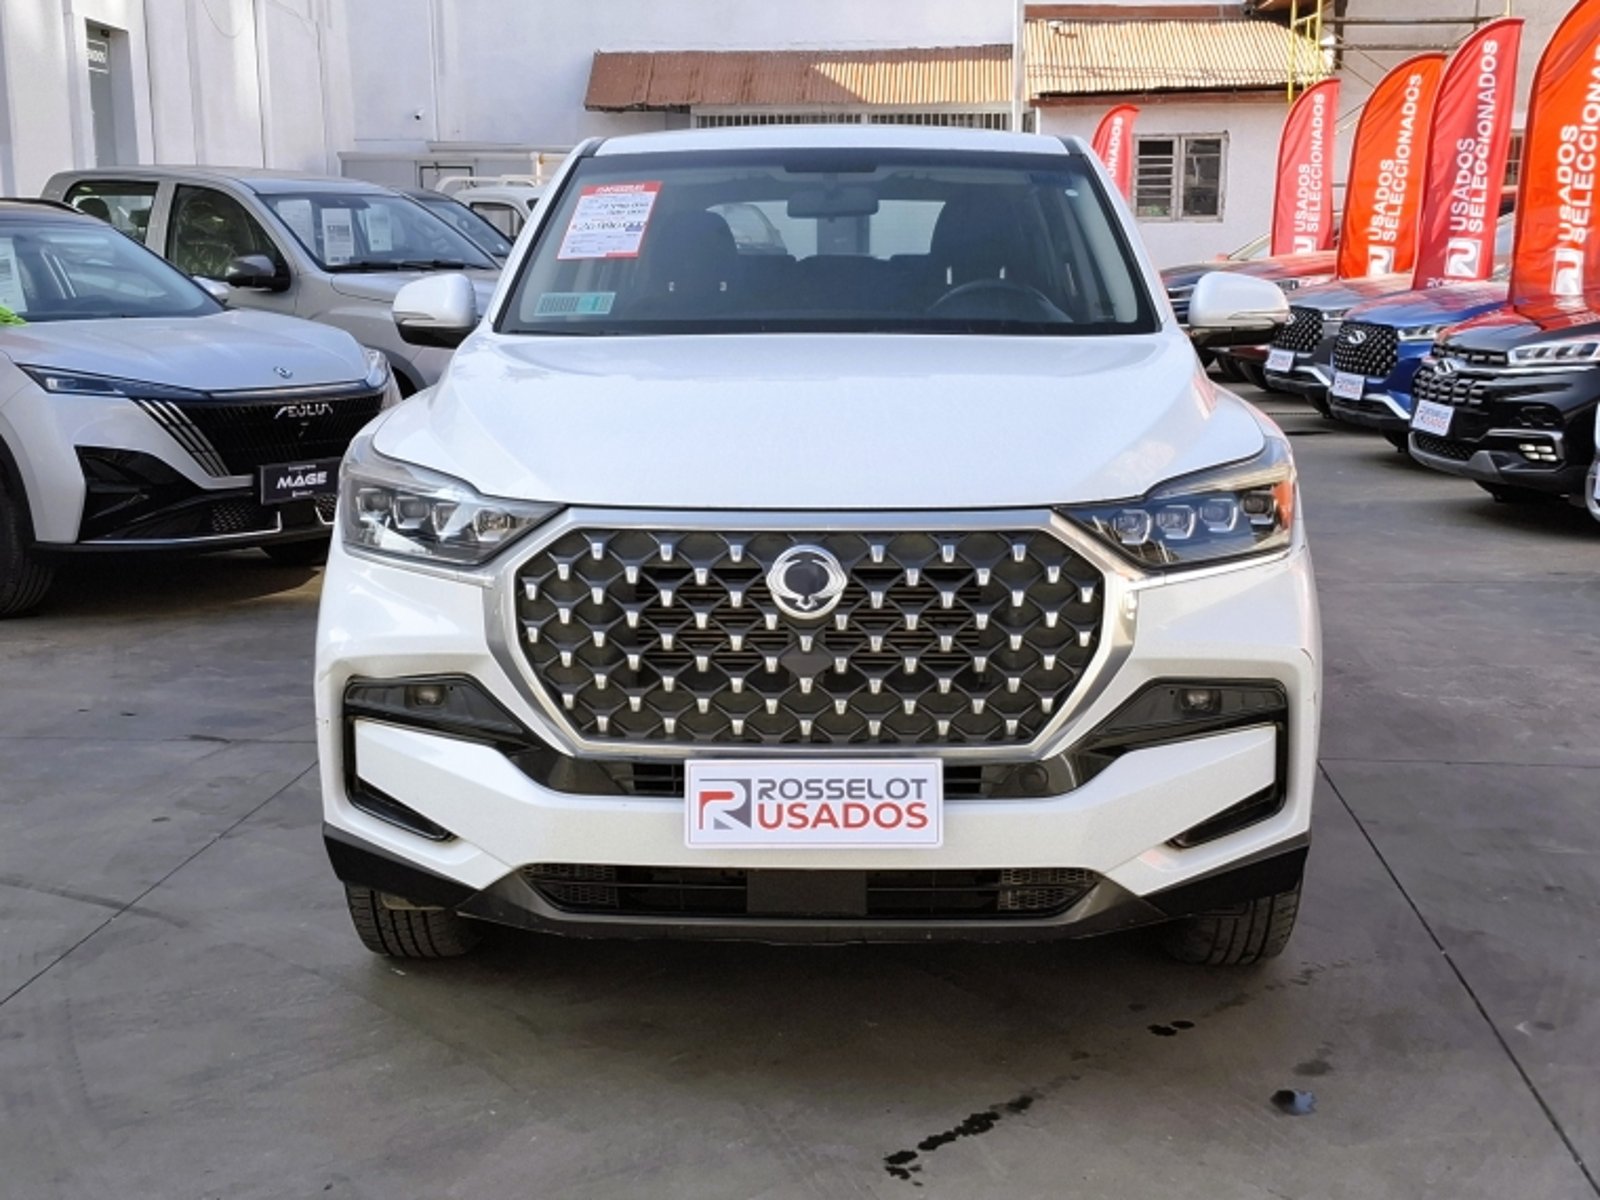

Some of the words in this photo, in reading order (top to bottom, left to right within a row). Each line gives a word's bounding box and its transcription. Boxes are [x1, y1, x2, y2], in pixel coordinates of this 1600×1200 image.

[1306, 93, 1325, 232] SELECCIONADOS
[1382, 74, 1422, 242] SELECCIONADOS
[1473, 40, 1498, 233] SELECCIONADOS
[1294, 163, 1310, 233] USADOS
[1368, 159, 1394, 241] USADOS
[1450, 138, 1475, 231] USADOS
[1557, 124, 1579, 241] USADOS
[276, 471, 328, 489] MAGE
[757, 778, 928, 800] ROSSELOT
[757, 802, 929, 829] USADOS
